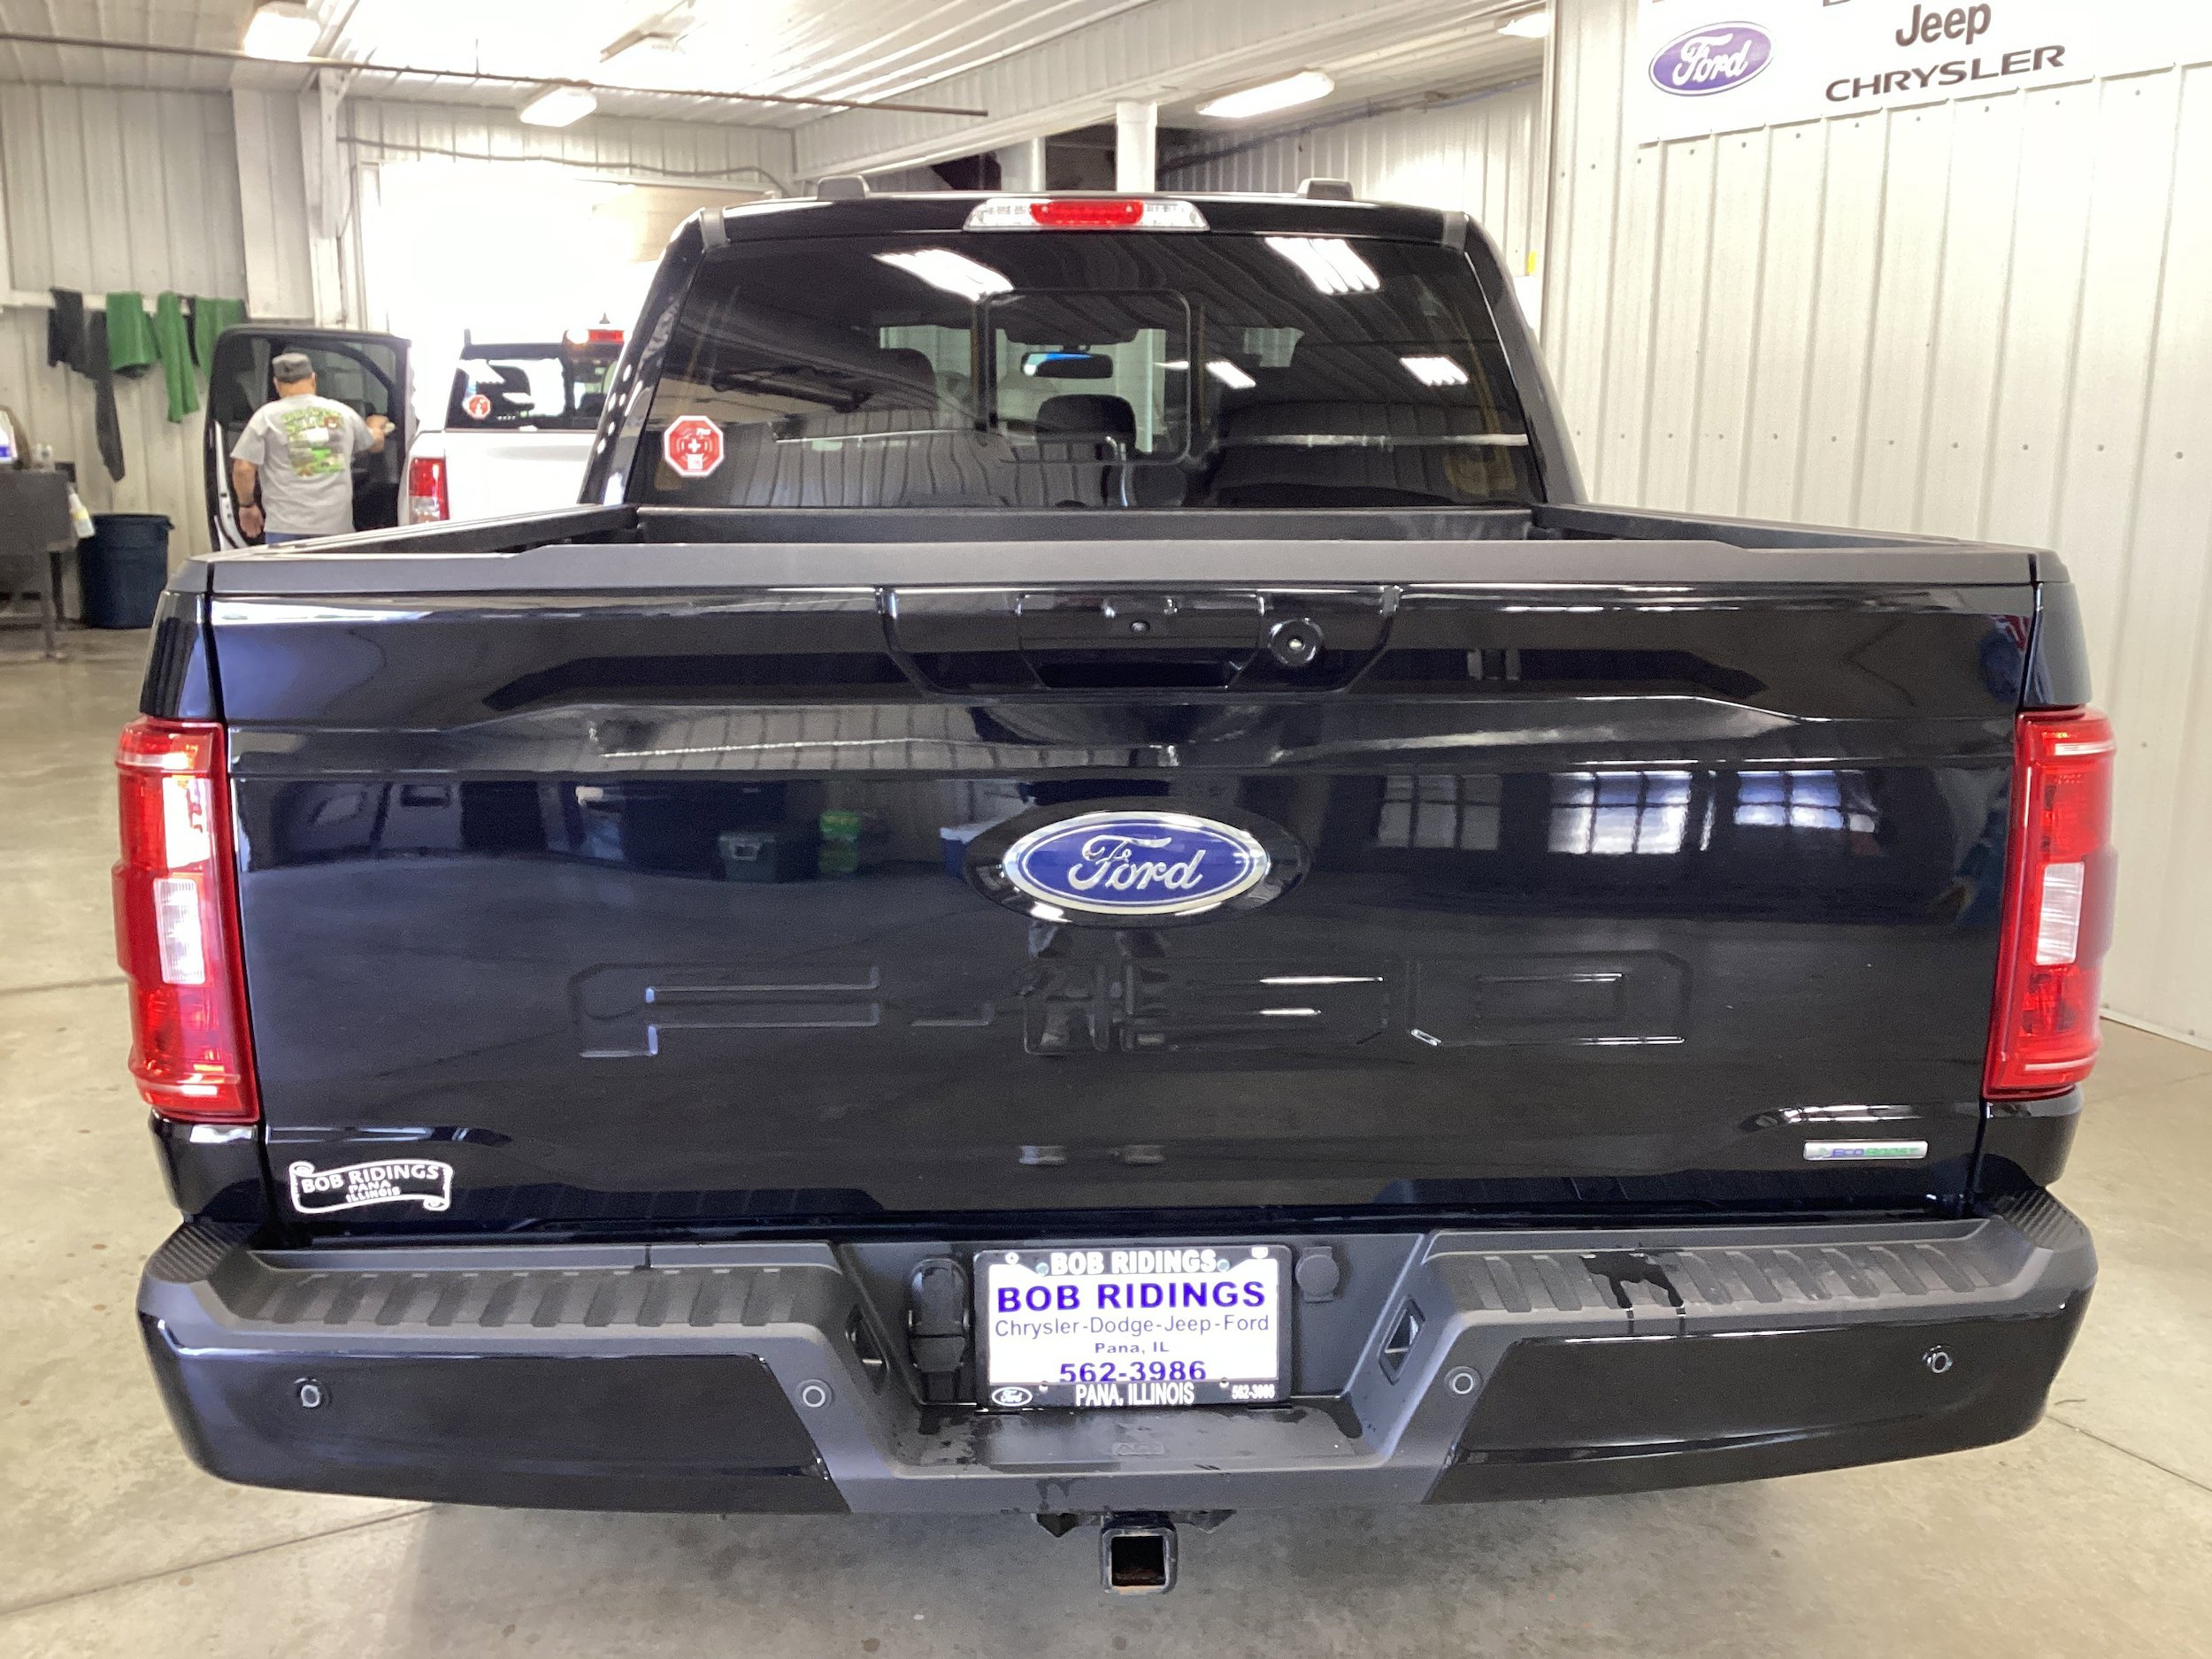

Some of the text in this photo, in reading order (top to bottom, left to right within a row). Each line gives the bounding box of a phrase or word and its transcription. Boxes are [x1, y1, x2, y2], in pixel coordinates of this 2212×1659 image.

[1895, 3, 1992, 47] Jeep
[1672, 33, 1752, 86] Ford
[1825, 44, 2066, 102] CHRYSLER
[1068, 834, 1207, 891] Ford
[301, 1164, 439, 1194] BOB RIDINGS
[349, 1179, 391, 1194] PANA
[1050, 1249, 1217, 1275] BOB RIDINGS
[998, 1281, 1265, 1312] BOB RIDINGS
[995, 1314, 1269, 1339] Chrysler-Dodge-Jeep-Ford
[1094, 1341, 1170, 1355] Pana, IL
[1059, 1360, 1206, 1382] 562-3986
[1076, 1381, 1194, 1406] PANA, ILLINOIS
